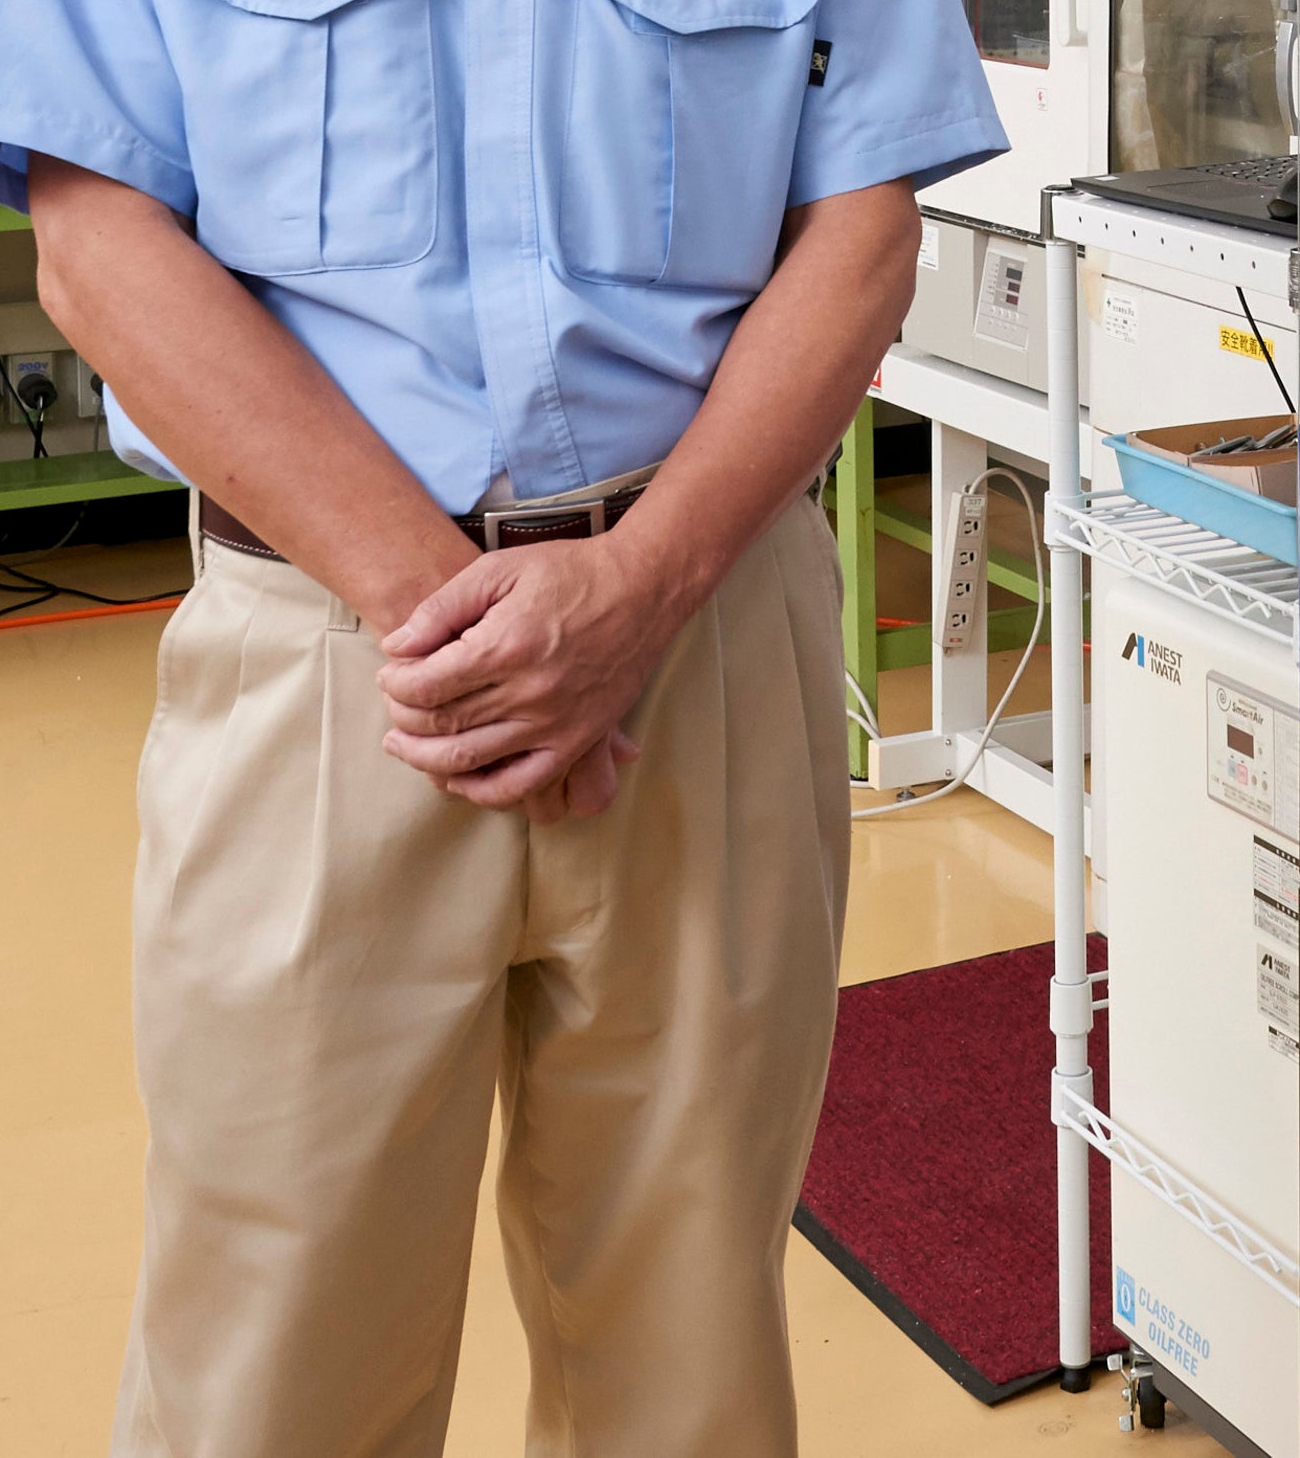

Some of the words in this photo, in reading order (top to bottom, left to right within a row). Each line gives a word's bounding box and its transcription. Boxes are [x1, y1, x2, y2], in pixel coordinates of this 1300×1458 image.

[18, 361, 49, 373] 200V
[1148, 640, 1183, 669] ANEST
[1150, 658, 1181, 686] IWATA
[1138, 1286, 1176, 1332] CLASS
[1177, 1318, 1211, 1360] ZERO
[1148, 1321, 1199, 1378] OILFREE
